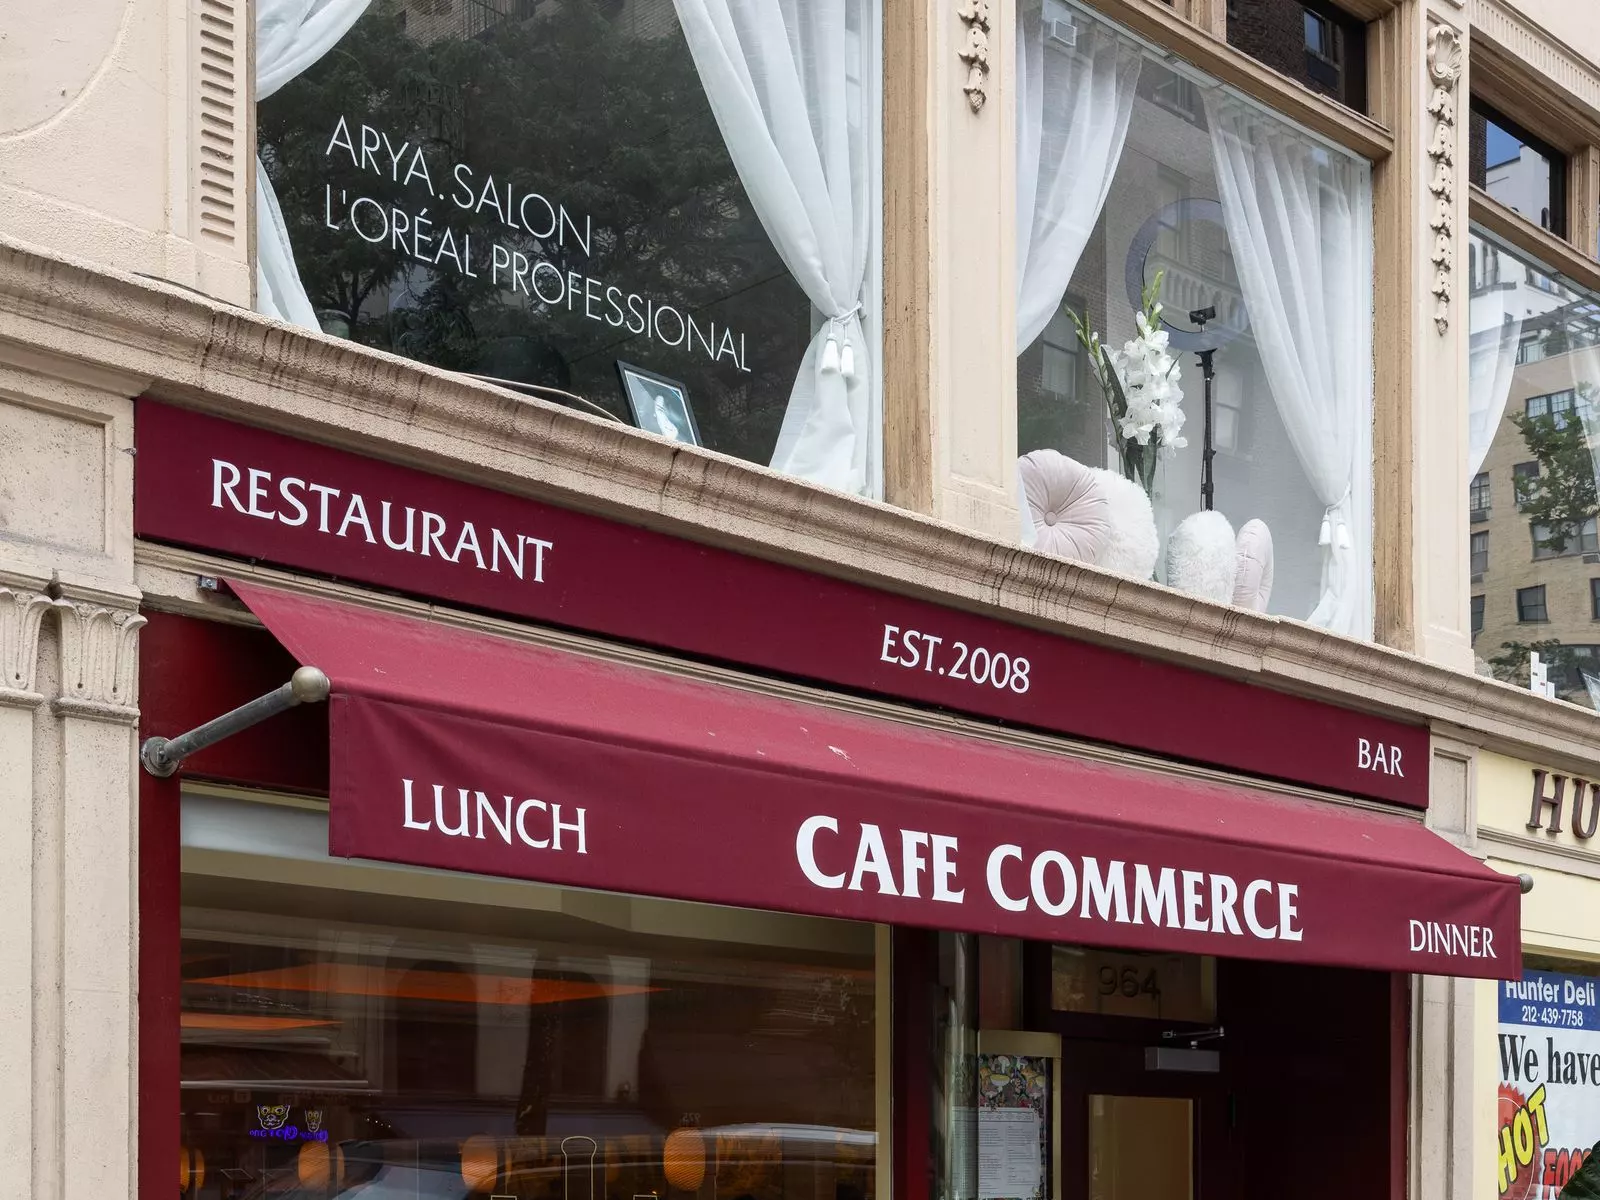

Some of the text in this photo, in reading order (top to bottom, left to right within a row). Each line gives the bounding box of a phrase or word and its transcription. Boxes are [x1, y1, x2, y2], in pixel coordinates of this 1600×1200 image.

[325, 183, 752, 373] L'ORÉAL PROFESSIONAL
[211, 457, 554, 584] RESTAURANT
[1357, 737, 1405, 778] BAR
[402, 778, 588, 854] LUNCH
[795, 815, 1304, 942] CAFE COMMERCE
[1409, 919, 1497, 959] DINNER
[1098, 963, 1162, 998] 964
[1505, 977, 1596, 1006] Hunter Deli
[1498, 1033, 1600, 1087] We have
[1498, 1082, 1549, 1194] HOT
